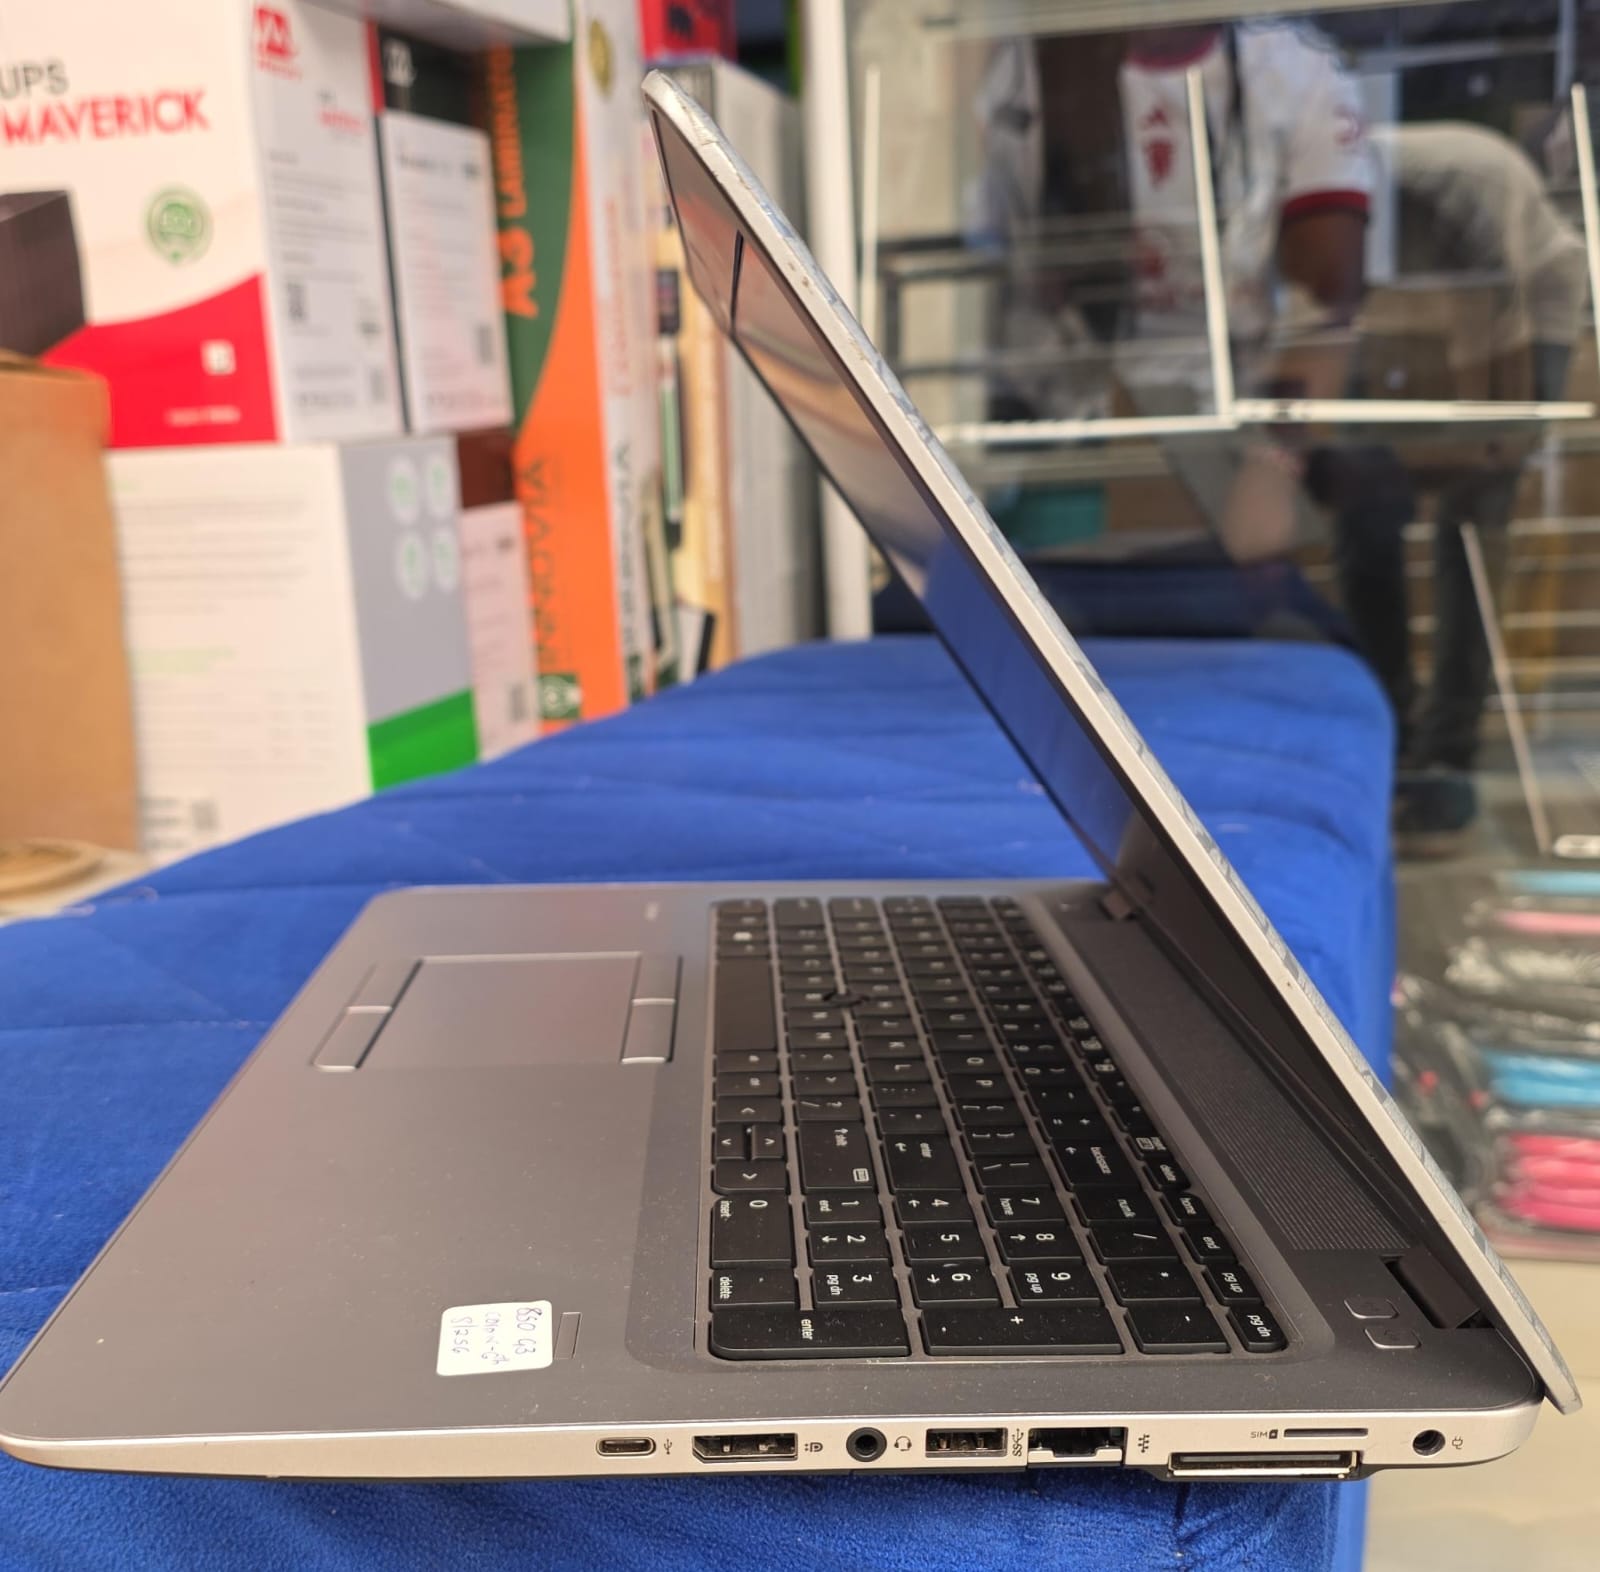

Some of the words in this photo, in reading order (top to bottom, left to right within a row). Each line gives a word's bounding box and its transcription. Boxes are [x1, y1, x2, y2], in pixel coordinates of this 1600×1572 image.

[0, 60, 69, 100] UPS
[1, 88, 208, 145] MAVERICK
[1091, 1146, 1112, 1174] backspace
[1159, 1164, 1177, 1182] delete
[748, 1199, 769, 1208] 0
[819, 1199, 832, 1212] end
[931, 1198, 950, 1207] 4
[999, 1197, 1014, 1216] home
[1020, 1197, 1041, 1205] 7
[1180, 1197, 1197, 1215] home
[720, 1200, 732, 1218] insert
[846, 1234, 867, 1243] 2
[940, 1233, 960, 1242] 5
[1035, 1233, 1055, 1241] 8
[1202, 1236, 1220, 1250] end
[852, 1273, 873, 1283] 3
[951, 1272, 972, 1282] 6
[1050, 1271, 1072, 1281] 9
[719, 1276, 734, 1299] delete
[516, 1307, 543, 1332] 850
[800, 1318, 814, 1341] enter
[1250, 1430, 1269, 1439] SIM
